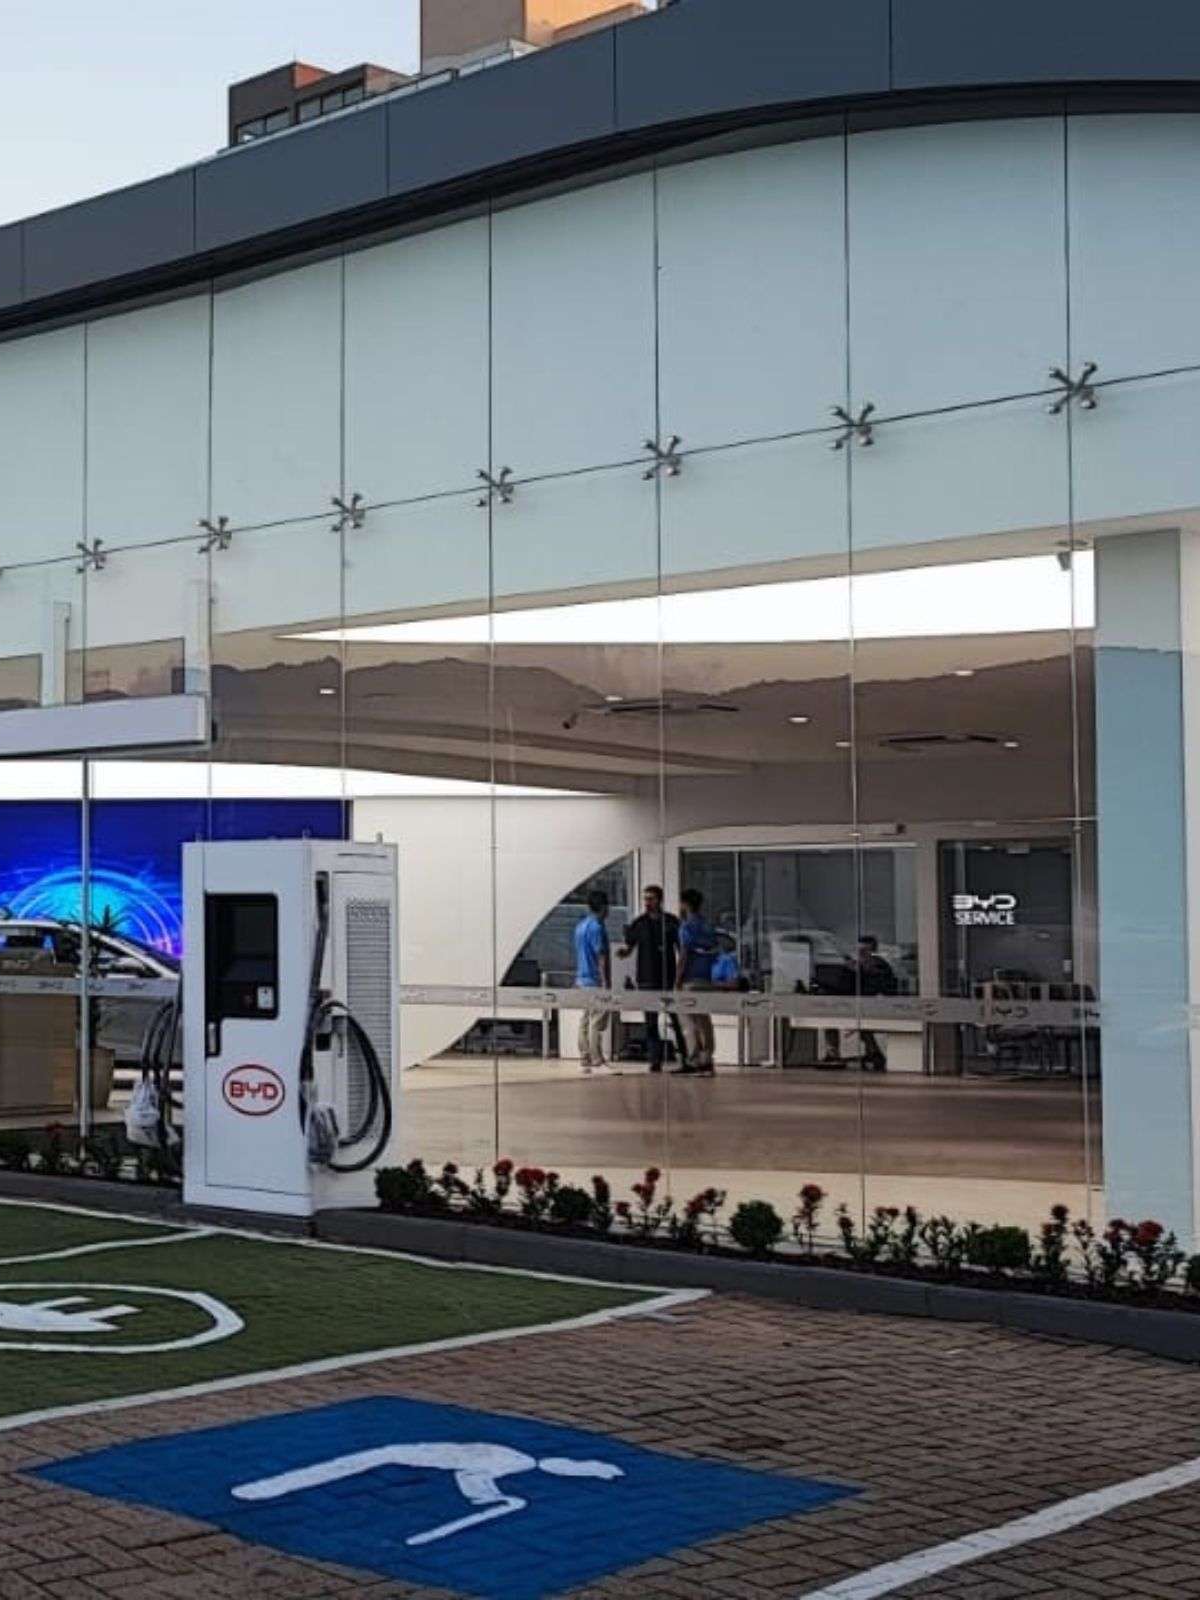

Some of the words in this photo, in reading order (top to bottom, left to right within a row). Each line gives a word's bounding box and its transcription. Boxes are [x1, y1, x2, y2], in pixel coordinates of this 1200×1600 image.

[953, 894, 1017, 909] BYD
[955, 911, 1015, 925] SERVICE
[229, 1080, 278, 1100] BYD
